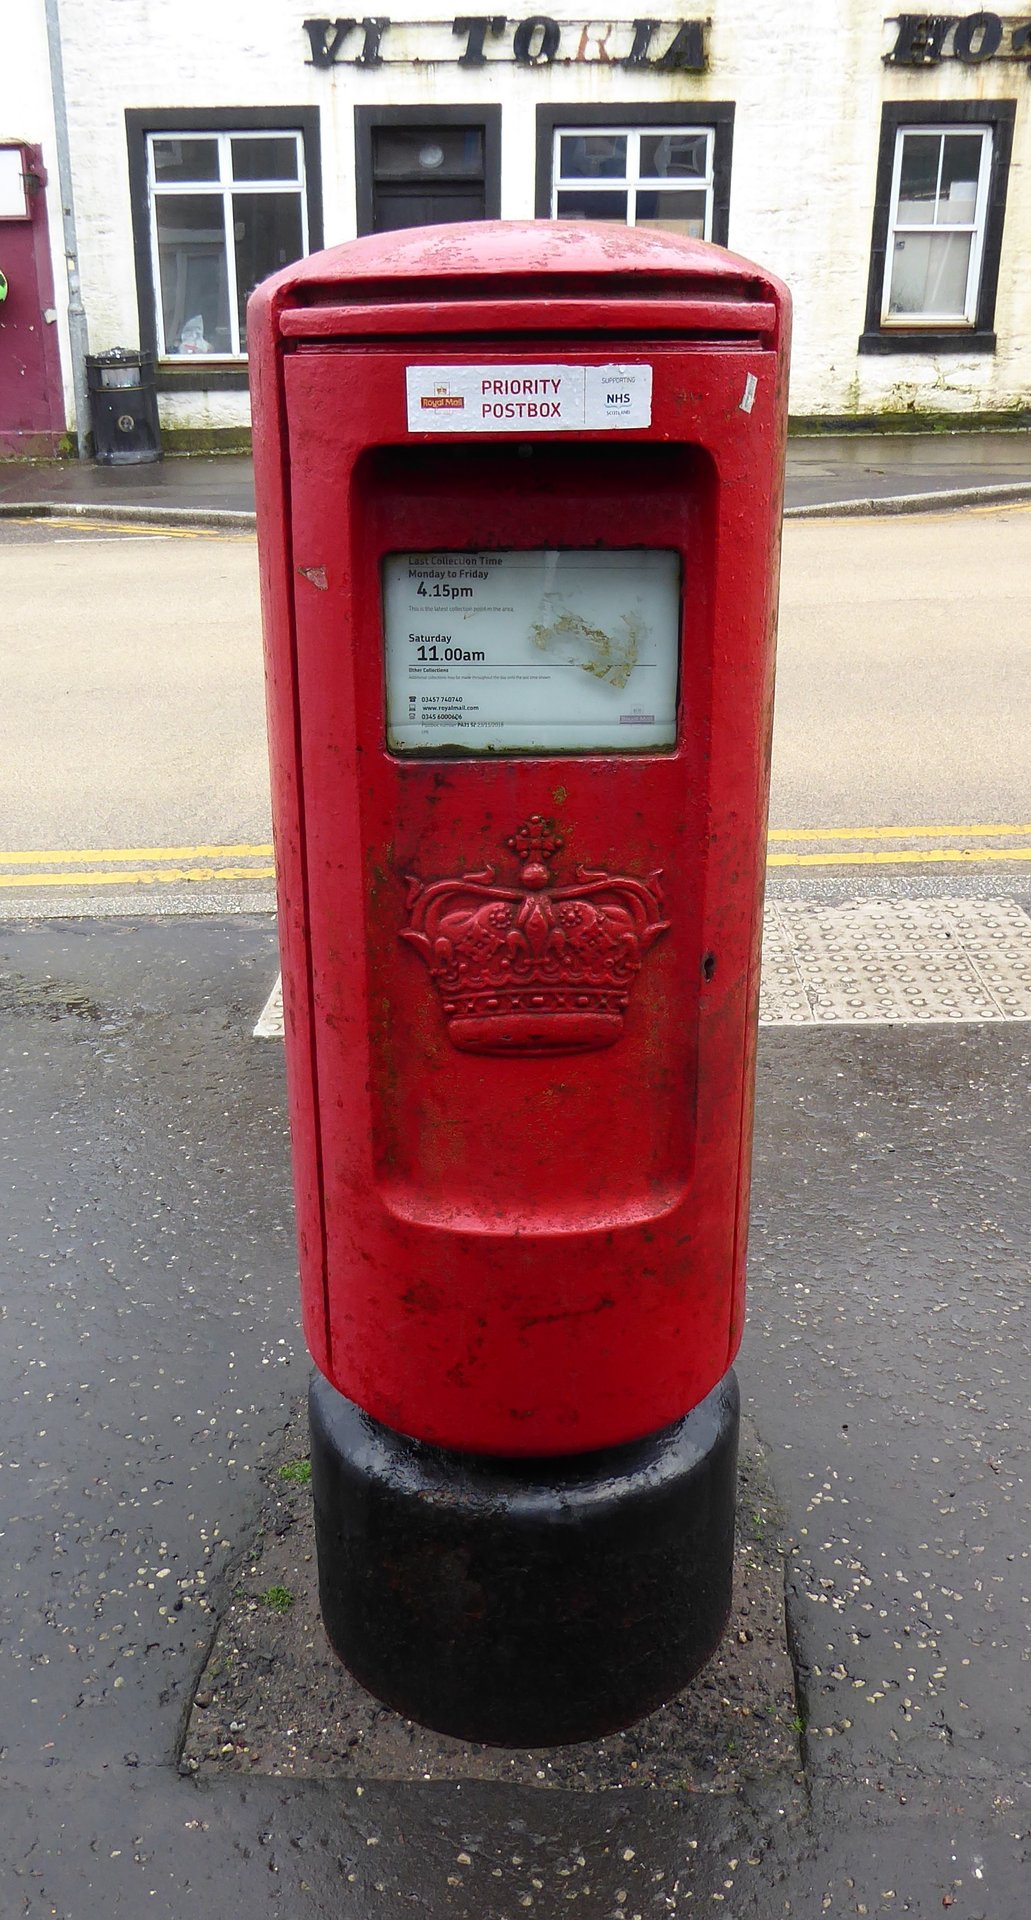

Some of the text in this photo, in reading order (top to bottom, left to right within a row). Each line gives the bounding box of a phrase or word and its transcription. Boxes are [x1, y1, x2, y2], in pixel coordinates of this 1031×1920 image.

[601, 376, 636, 384] SUPPORTING
[481, 379, 562, 395] PRIORITY
[422, 398, 463, 408] Royal Mail
[606, 393, 631, 404] NHS
[481, 402, 562, 418] POSTBOX
[408, 557, 503, 566] Last Collection Time
[408, 569, 489, 580] Monday to Friday
[416, 581, 473, 600] 4.15pm
[408, 633, 452, 644] Saturday
[417, 645, 485, 661] 11.00am
[422, 704, 480, 712] www.royalmail.com
